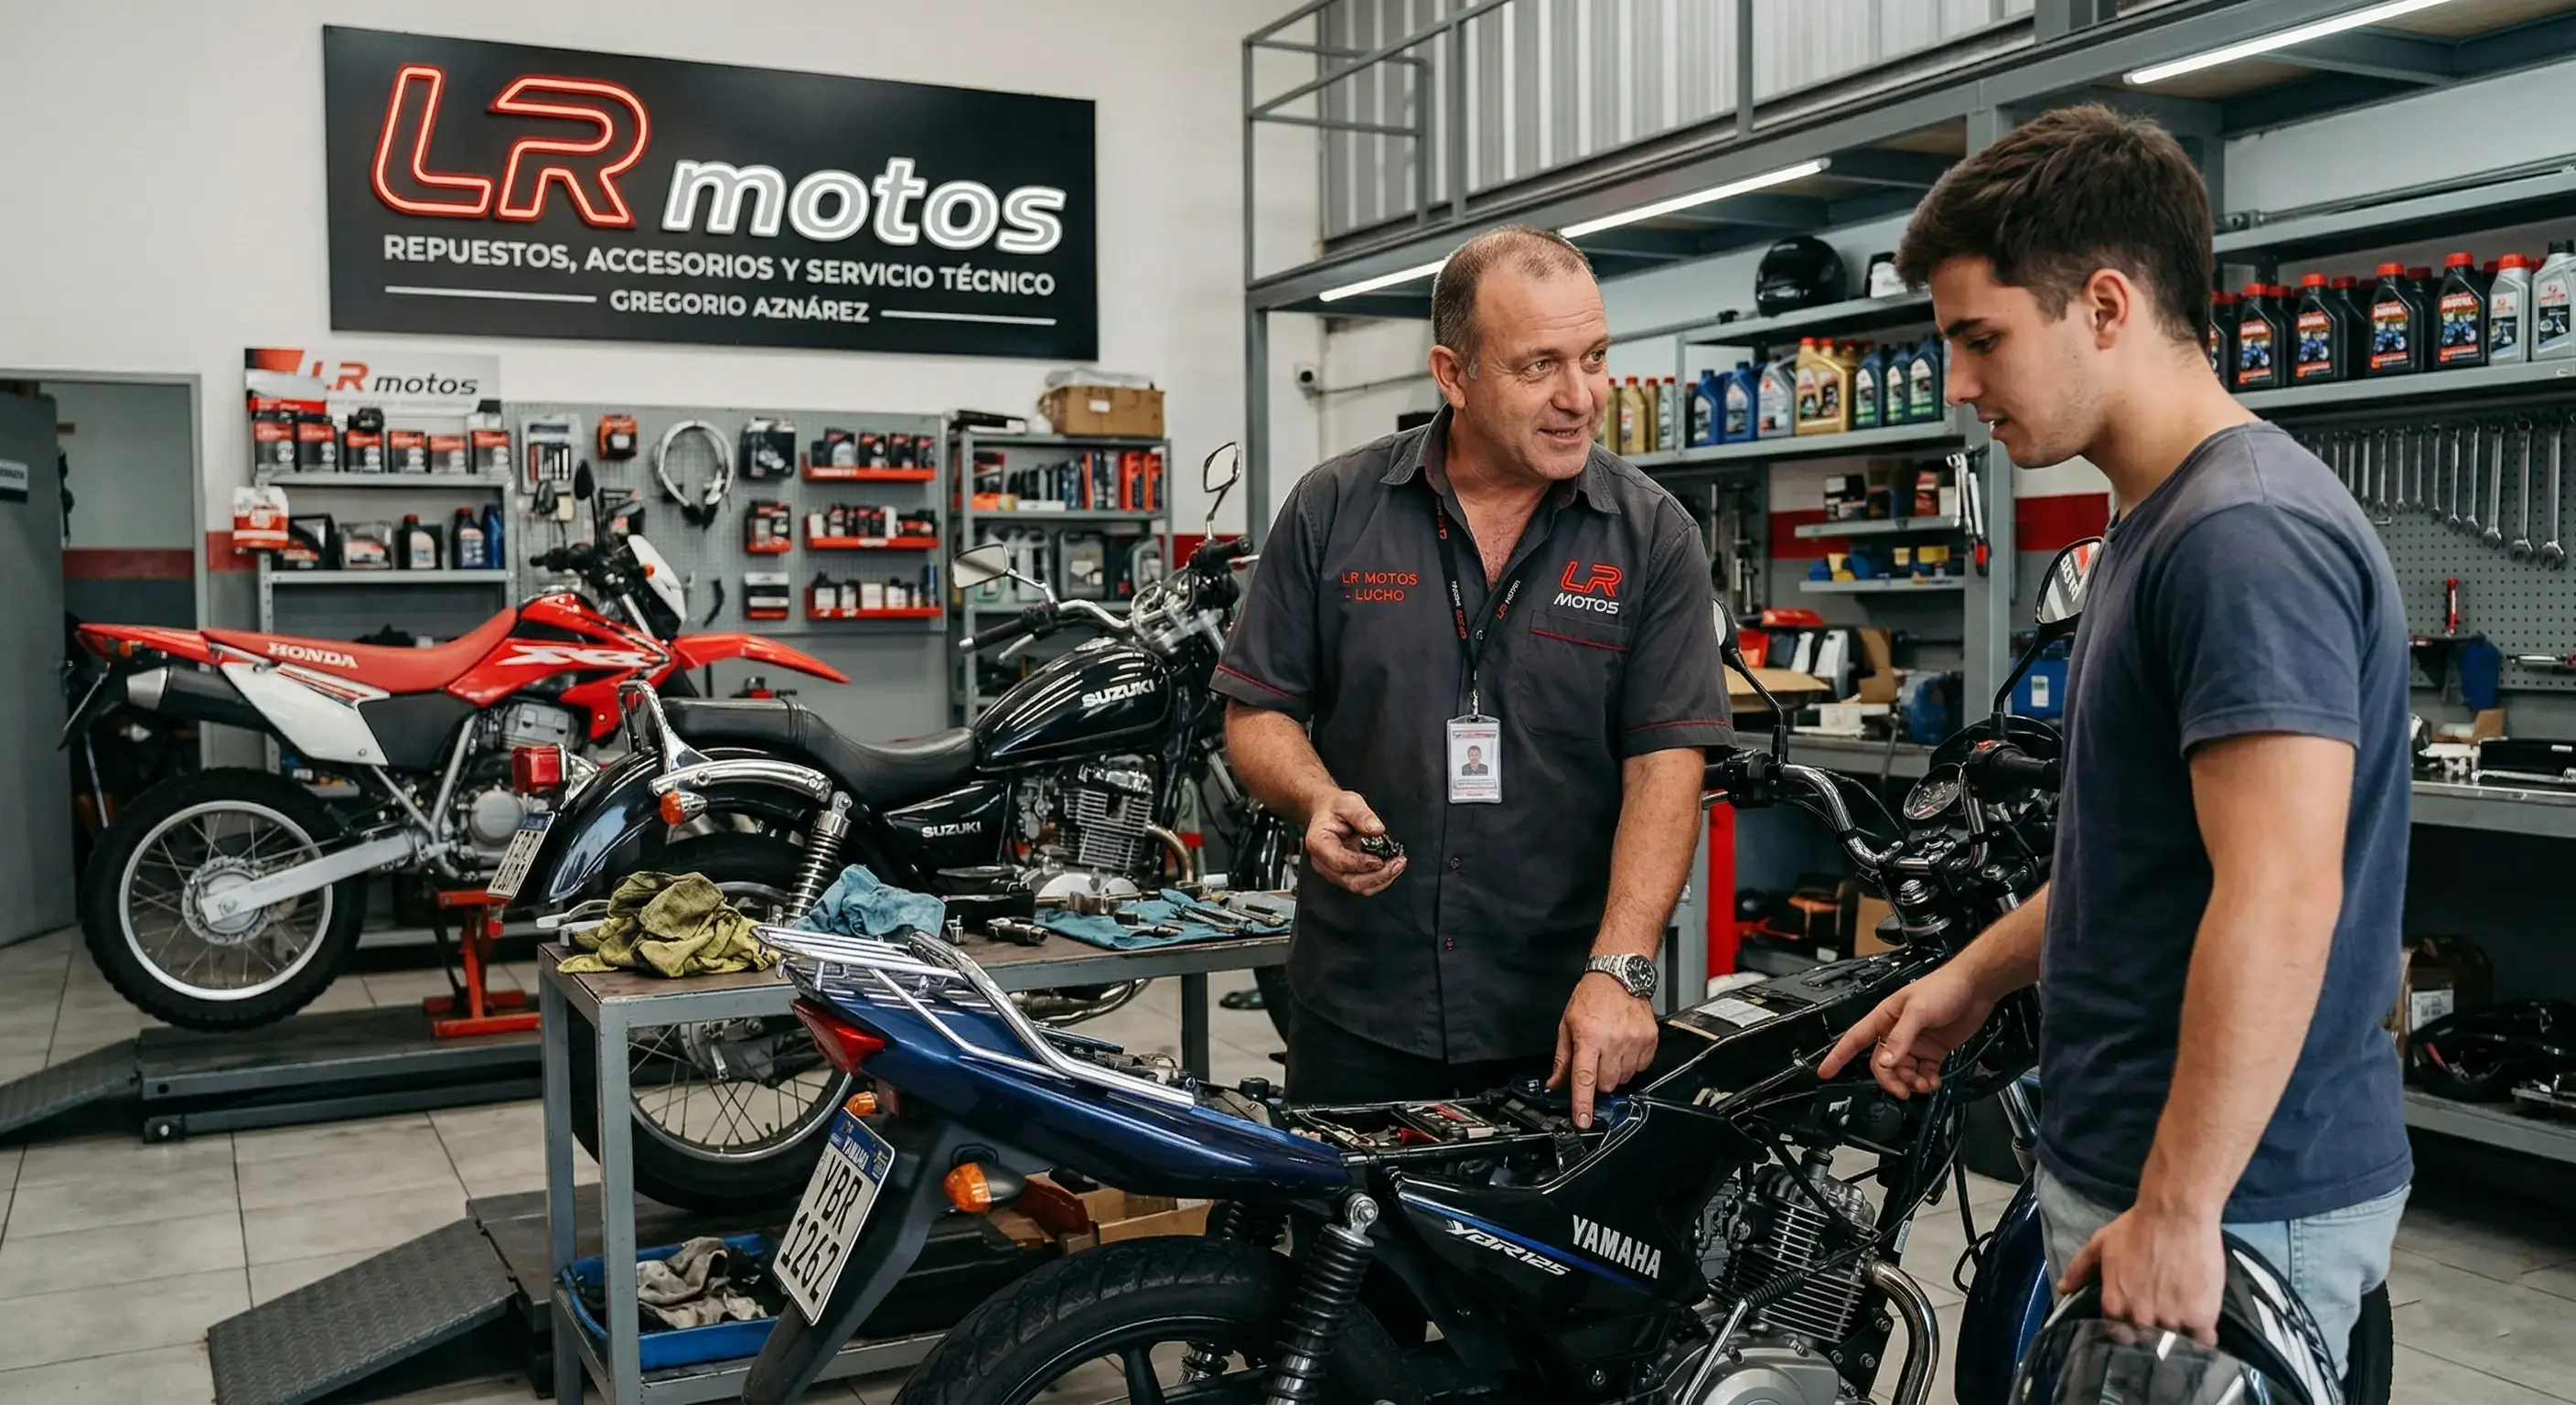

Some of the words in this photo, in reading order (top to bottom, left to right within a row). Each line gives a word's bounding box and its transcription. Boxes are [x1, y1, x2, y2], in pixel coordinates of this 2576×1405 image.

[371, 63, 650, 228] LR
[661, 156, 1067, 254] motos
[384, 234, 577, 273] REPUESTOS,
[584, 247, 774, 280] ACCESORIOS
[780, 257, 800, 281] Y
[805, 259, 934, 289] SERVICIO
[939, 263, 1056, 296] TÉCNICO
[609, 289, 746, 316] GREGORIO
[752, 295, 870, 323] AZNÁREZ
[374, 372, 478, 395] motos
[1341, 572, 1359, 584] LR
[1365, 572, 1418, 585] MOTOS
[1356, 588, 1404, 601] LUCHO
[1561, 560, 1623, 597] LR
[1553, 592, 1620, 614] MOTOS
[268, 642, 359, 669] HONDA
[1081, 678, 1155, 708] SUZUKI
[921, 821, 982, 838] SUZUKI
[814, 1154, 863, 1235] YBR
[780, 1211, 840, 1303] 1262
[1445, 1219, 1572, 1276] YBR125
[1572, 1215, 1661, 1279] YAMAHA
